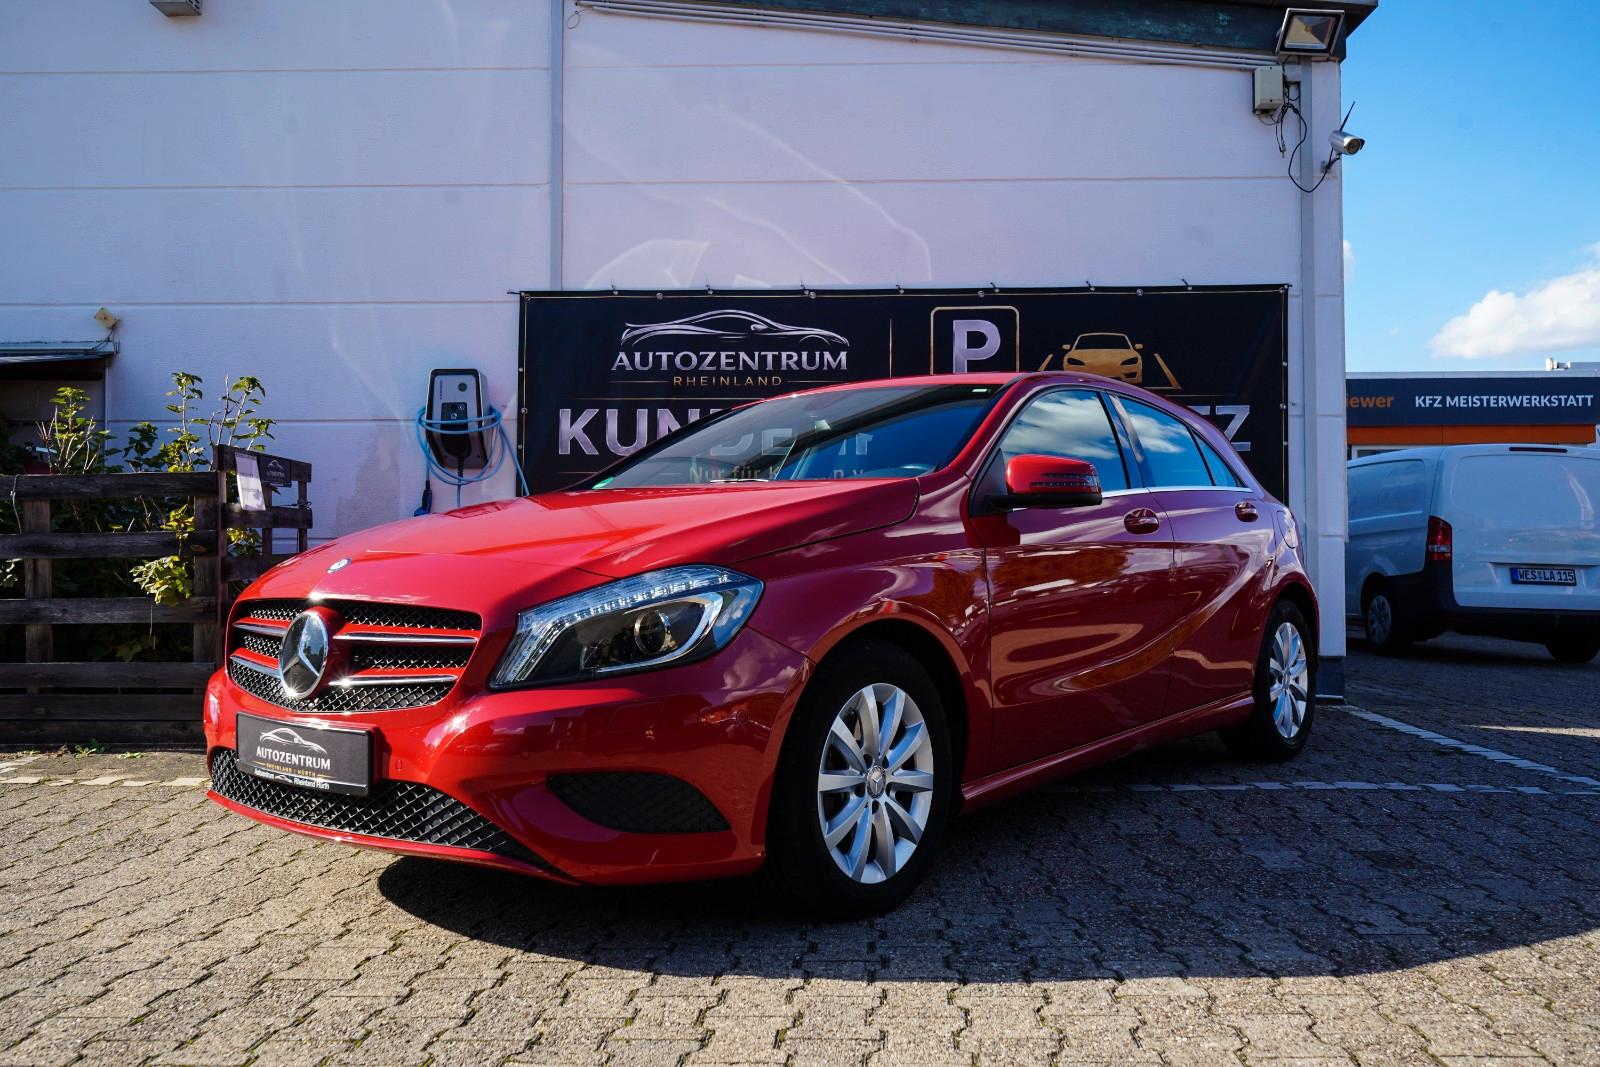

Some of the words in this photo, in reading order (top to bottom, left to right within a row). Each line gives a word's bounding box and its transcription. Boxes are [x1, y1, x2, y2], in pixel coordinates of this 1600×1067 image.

[952, 319, 1001, 374] P
[610, 351, 848, 372] AUTOZENTRUM
[673, 376, 783, 387] RHEINLAND
[1415, 395, 1442, 408] KFZ
[1446, 394, 1594, 408] MEISTERWERKSTATT
[256, 746, 331, 771] AUTOZENTRUM
